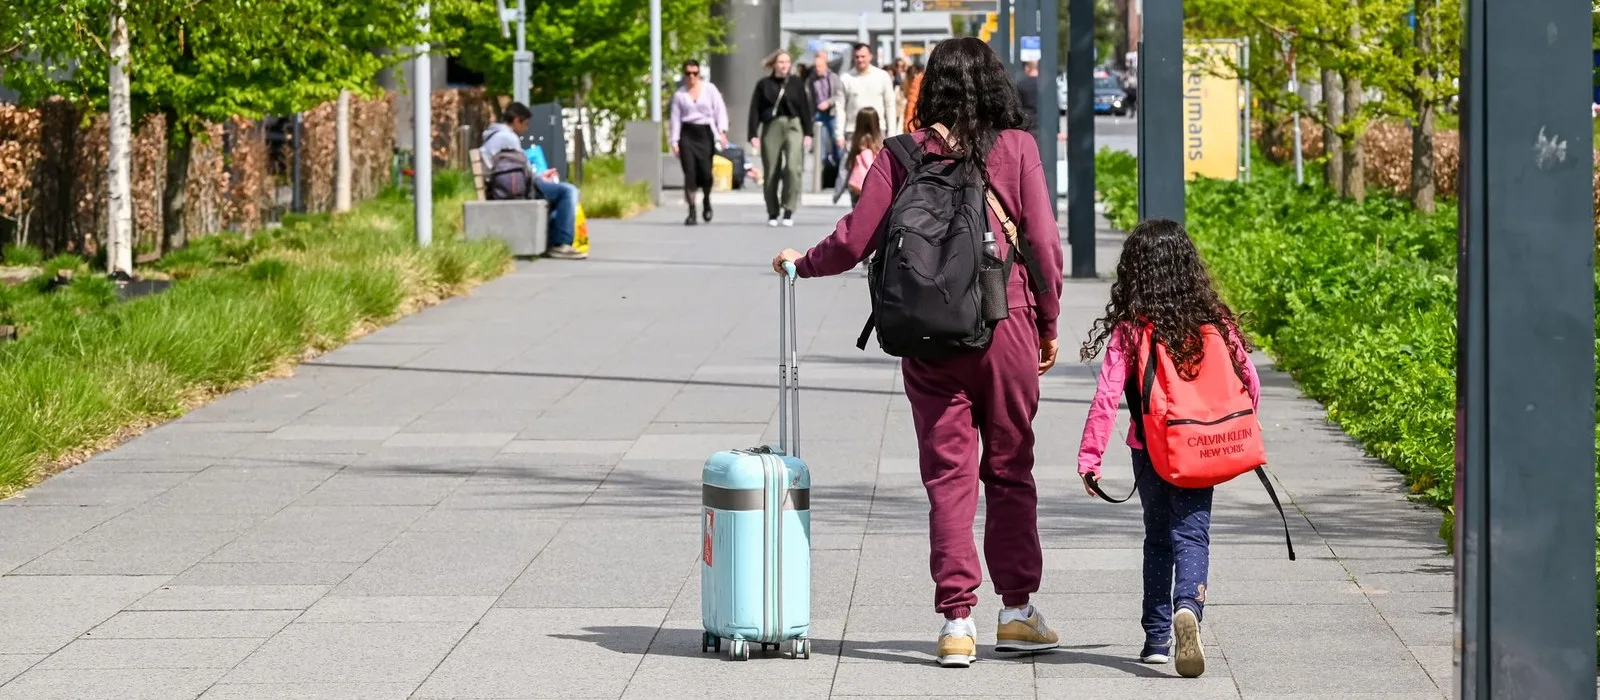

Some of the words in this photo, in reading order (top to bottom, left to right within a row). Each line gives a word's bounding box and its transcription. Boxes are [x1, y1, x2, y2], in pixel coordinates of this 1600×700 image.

[1187, 433, 1226, 447] CALVIN
[1227, 428, 1252, 442] KLEIN
[1200, 448, 1221, 458] NEW
[1222, 444, 1244, 455] YORK
